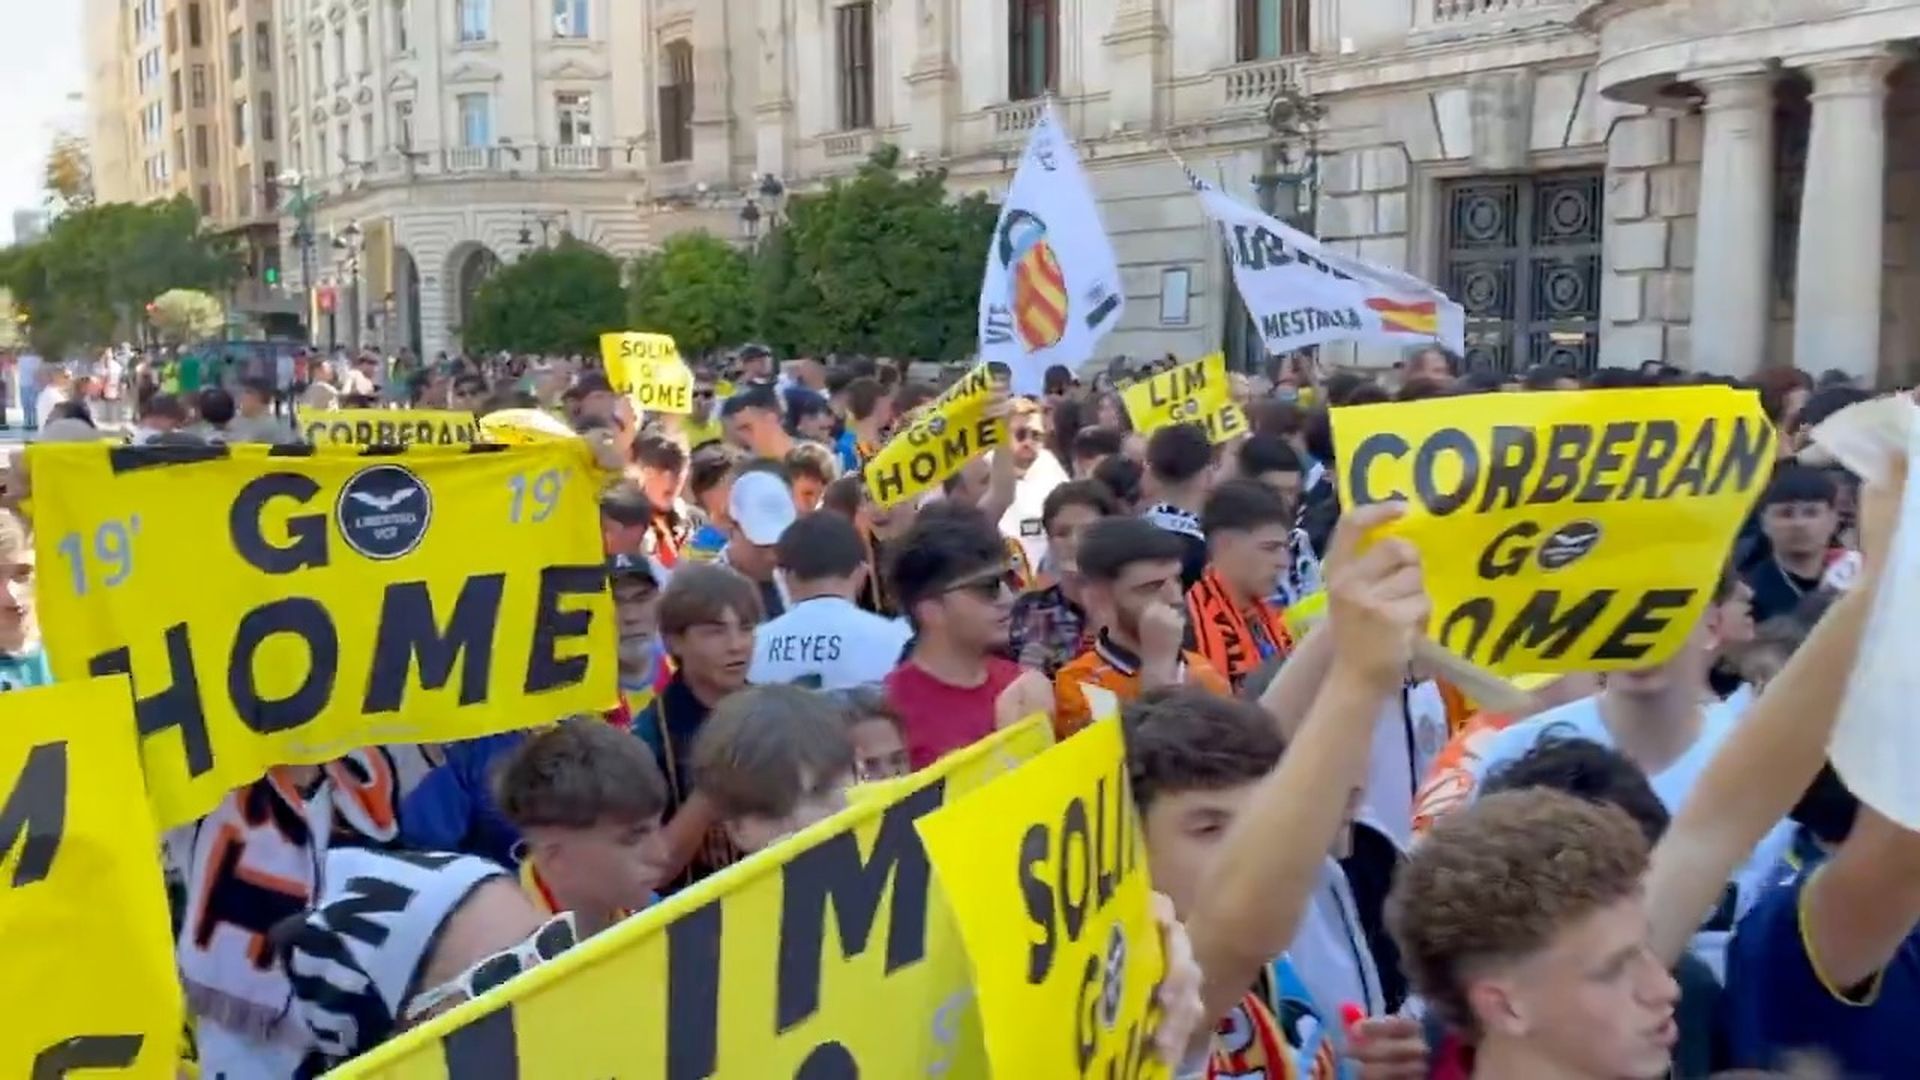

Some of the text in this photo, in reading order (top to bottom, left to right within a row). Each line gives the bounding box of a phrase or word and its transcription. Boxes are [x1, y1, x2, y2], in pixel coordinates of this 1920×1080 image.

[1149, 361, 1206, 407] LIM
[877, 417, 999, 502] HOME
[1350, 416, 1771, 517] CORBERAN
[768, 634, 843, 663] REYES
[1439, 588, 1698, 667] OME
[88, 563, 608, 780] HOME
[1018, 760, 1136, 986] SOLI
